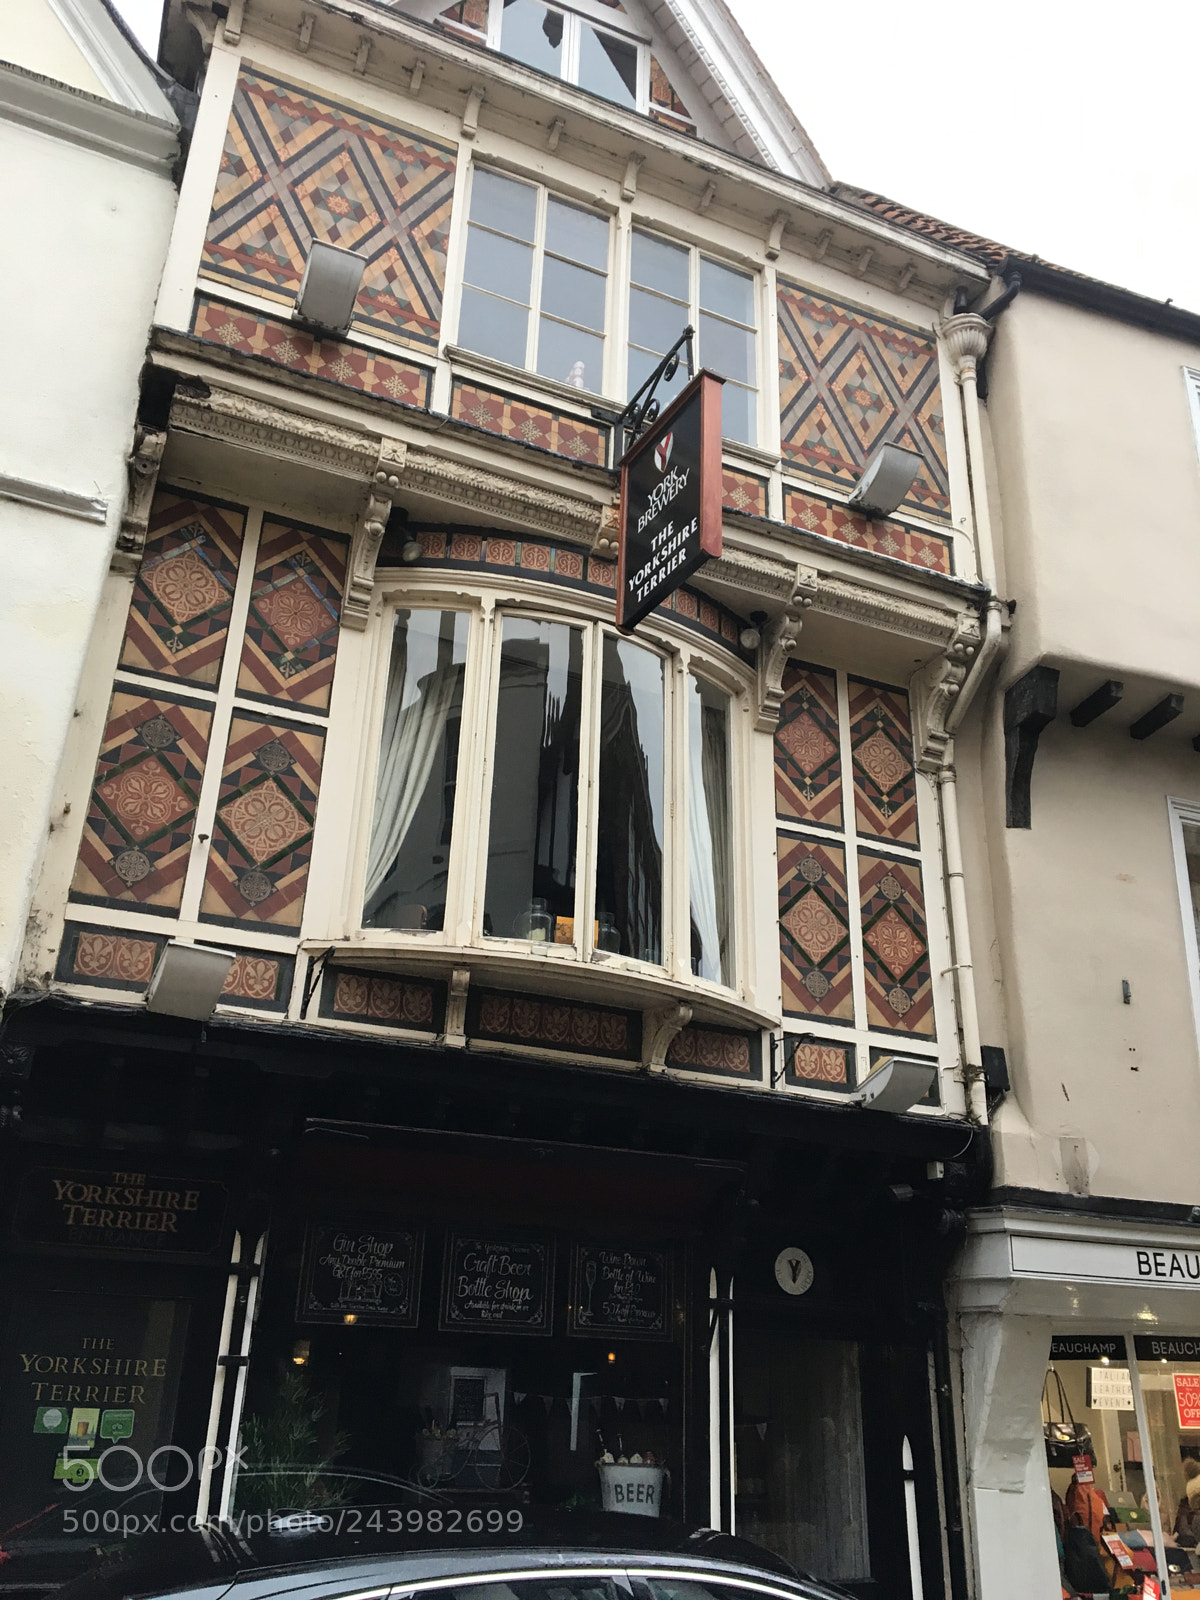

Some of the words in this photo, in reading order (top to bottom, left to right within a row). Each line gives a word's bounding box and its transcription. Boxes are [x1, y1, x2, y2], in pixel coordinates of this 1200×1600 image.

[647, 466, 678, 502] YORK
[637, 468, 690, 534] BREWERY
[650, 520, 675, 552] THE
[628, 517, 698, 592] YORKSHIRE
[636, 547, 688, 603] TERRIER
[112, 1171, 147, 1186] THE
[52, 1179, 200, 1211] YORKSHIRE
[62, 1203, 178, 1232] TERRIER
[333, 1233, 356, 1253] Gin
[357, 1234, 394, 1258] Shop
[463, 1252, 498, 1278] Craft
[498, 1255, 532, 1276] Beer
[1136, 1250, 1200, 1280] BEAU
[456, 1275, 493, 1298] Bottle
[494, 1279, 534, 1305] Shop
[81, 1337, 117, 1351] THE
[19, 1353, 168, 1377] YORKSHIRE
[31, 1381, 146, 1404] TERRIER
[1176, 1377, 1200, 1388] SALE
[614, 1483, 655, 1505] BEER
